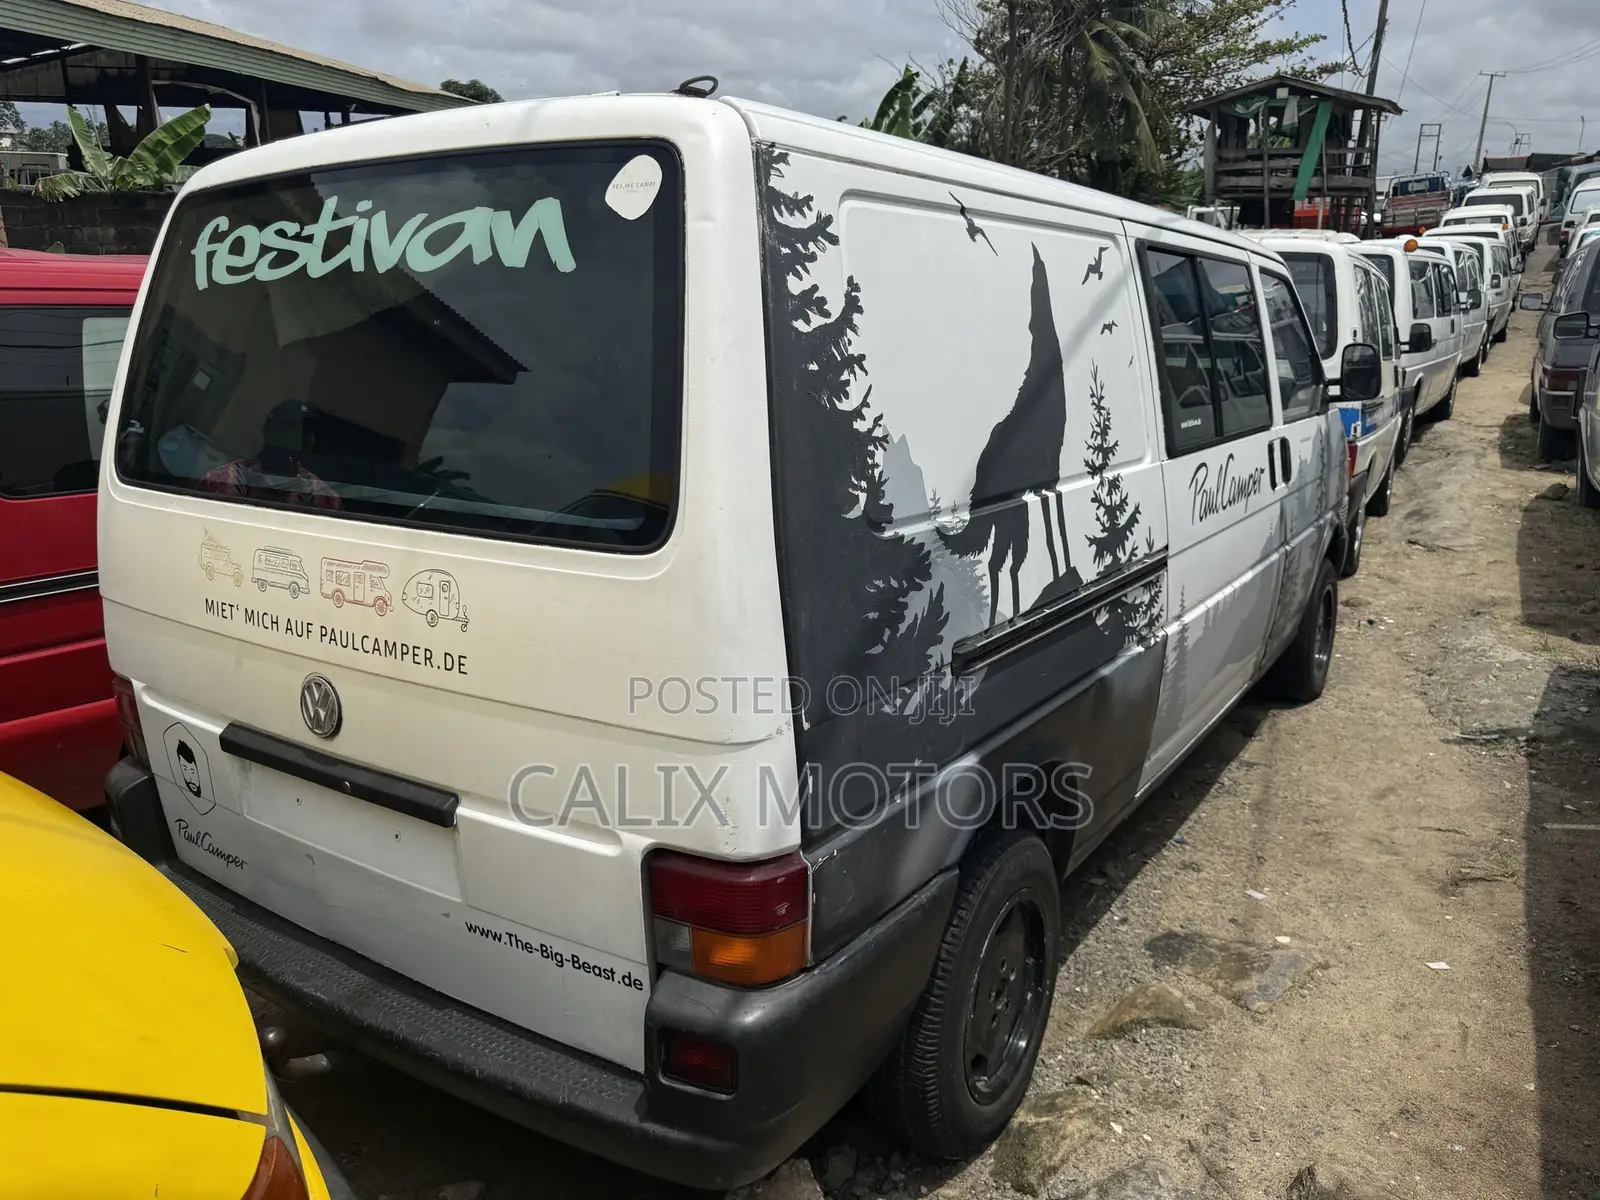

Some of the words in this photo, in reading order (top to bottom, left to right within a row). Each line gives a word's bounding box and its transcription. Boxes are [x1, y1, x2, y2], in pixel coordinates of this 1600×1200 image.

[191, 195, 577, 290] festivan
[1188, 452, 1265, 526] PaulCamper
[244, 608, 280, 632] MICH
[285, 618, 313, 640] AUF
[320, 625, 468, 675] PAULCAMPER.DE
[174, 818, 248, 870] PaulCamper
[465, 921, 644, 991] www.The-Big-Beast.de
